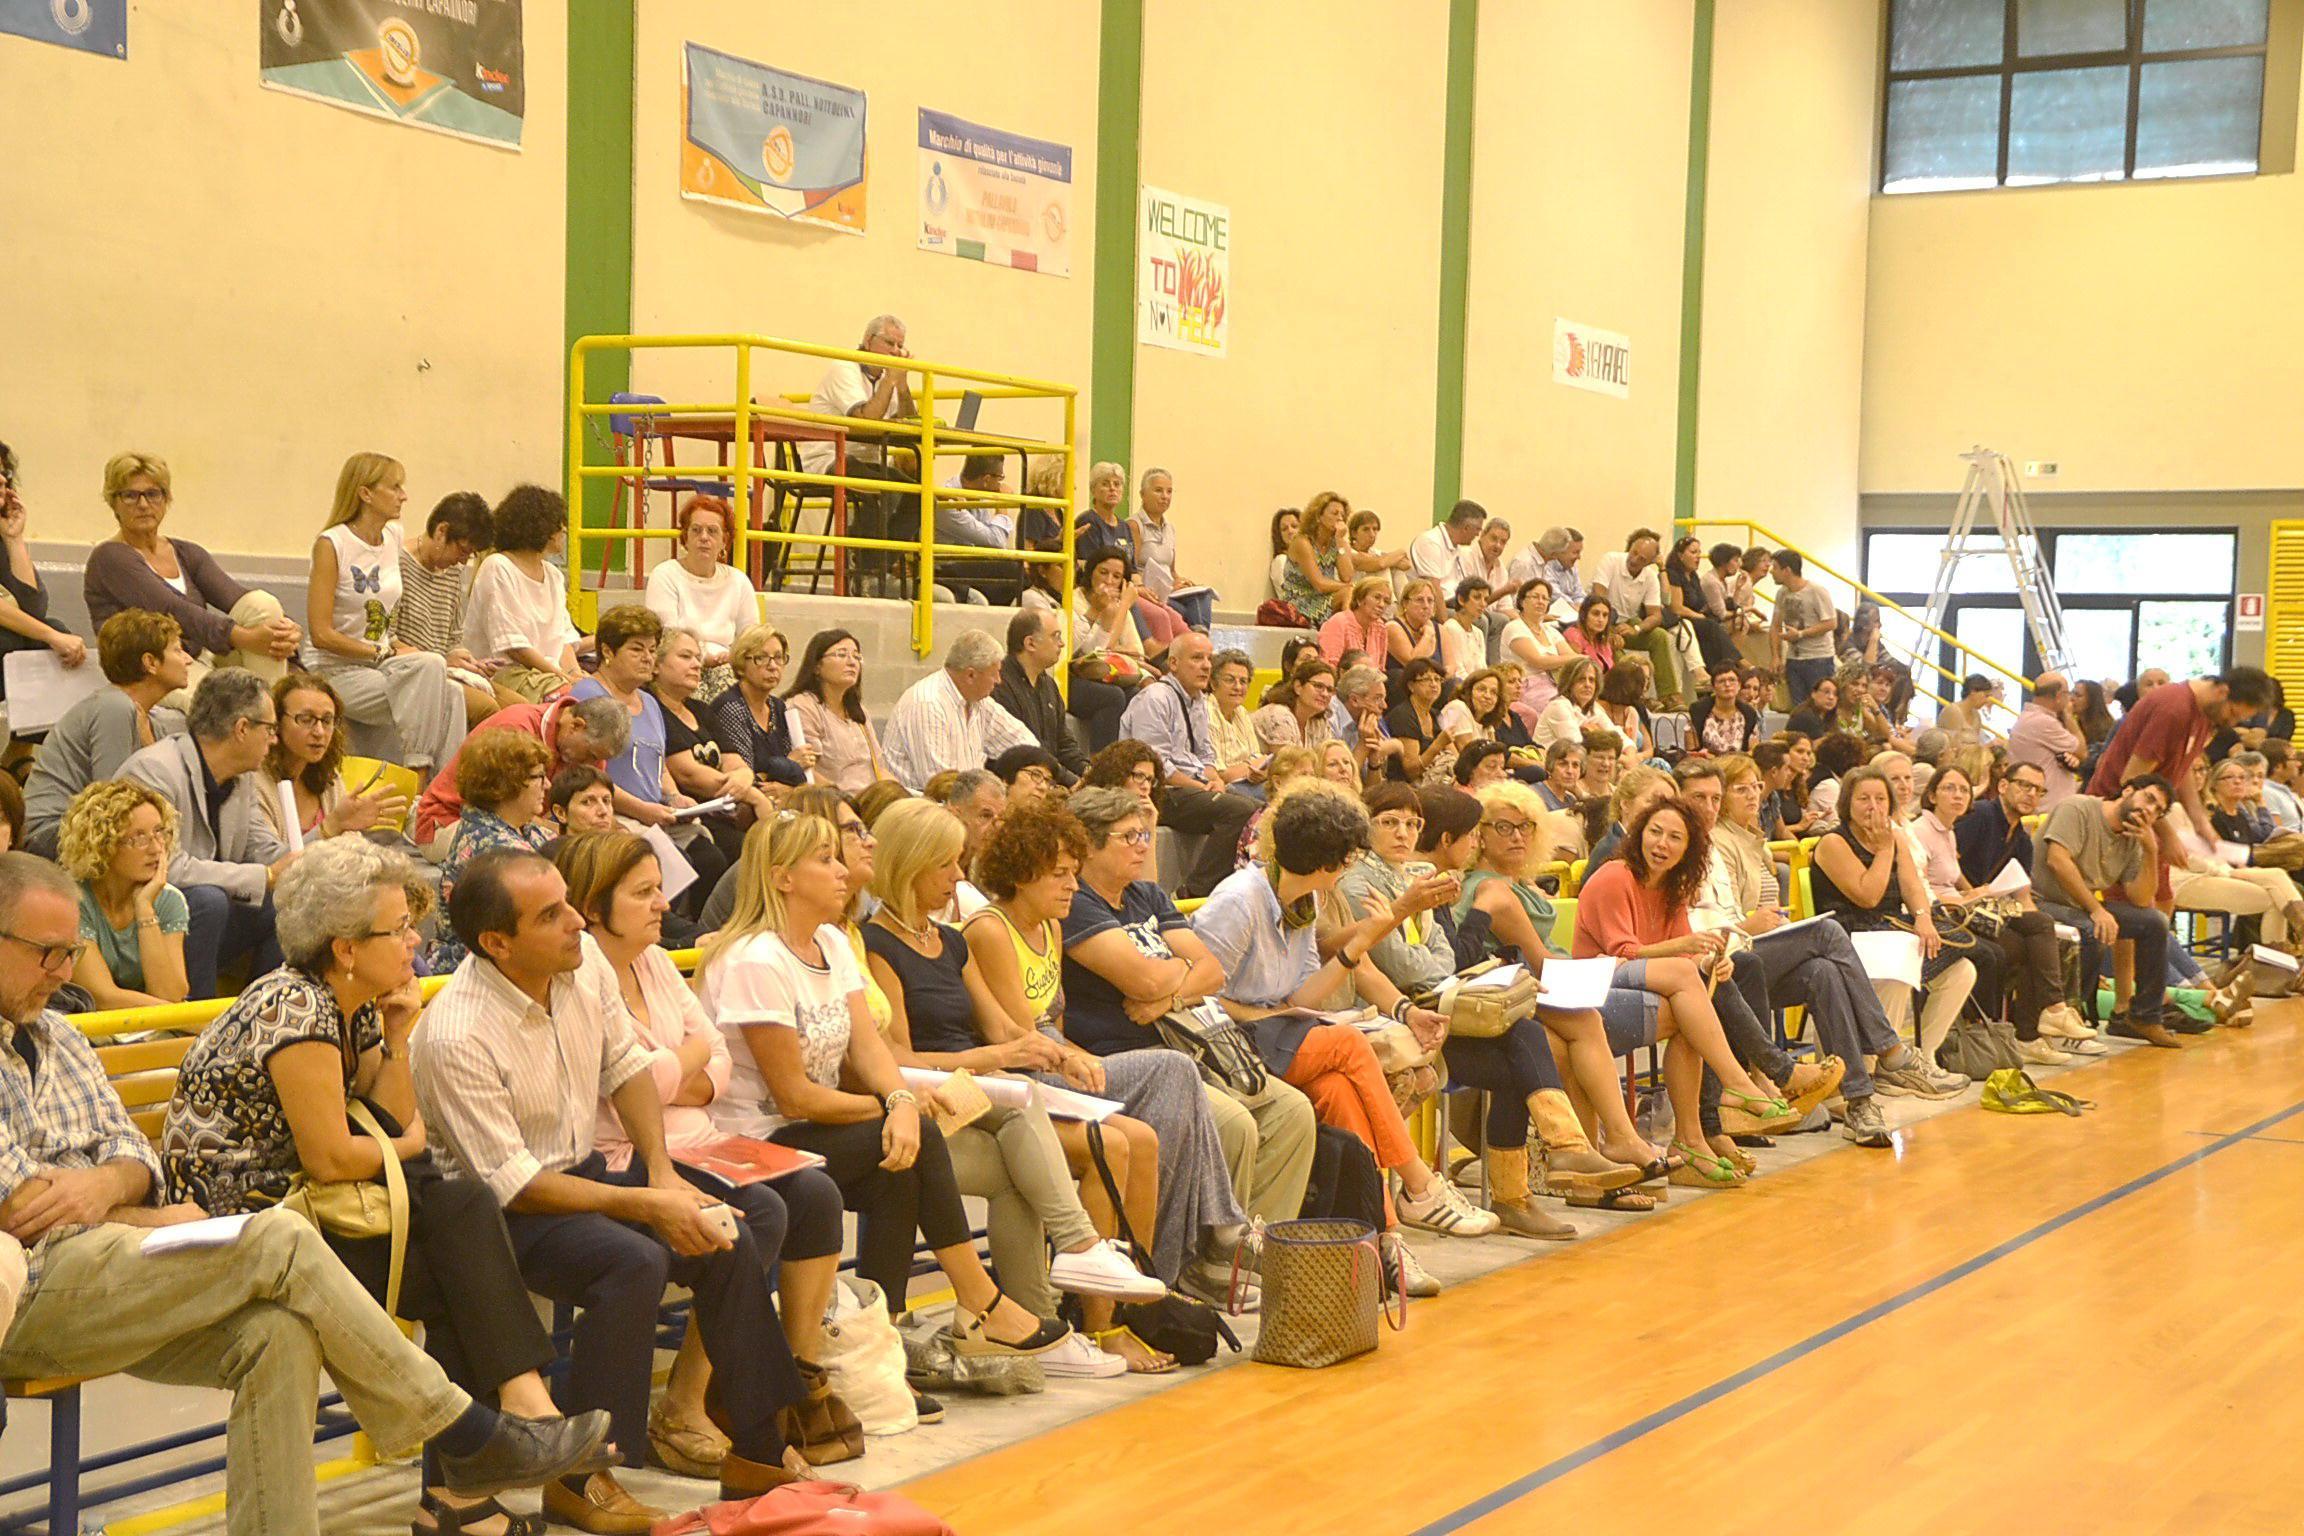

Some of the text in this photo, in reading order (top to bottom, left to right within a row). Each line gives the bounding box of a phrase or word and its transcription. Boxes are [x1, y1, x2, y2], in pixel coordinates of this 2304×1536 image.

[929, 128, 962, 152] Marchio
[964, 138, 972, 154] di
[996, 149, 1008, 164] per
[1147, 198, 1227, 251] WELCOME
[1150, 257, 1176, 296] TO
